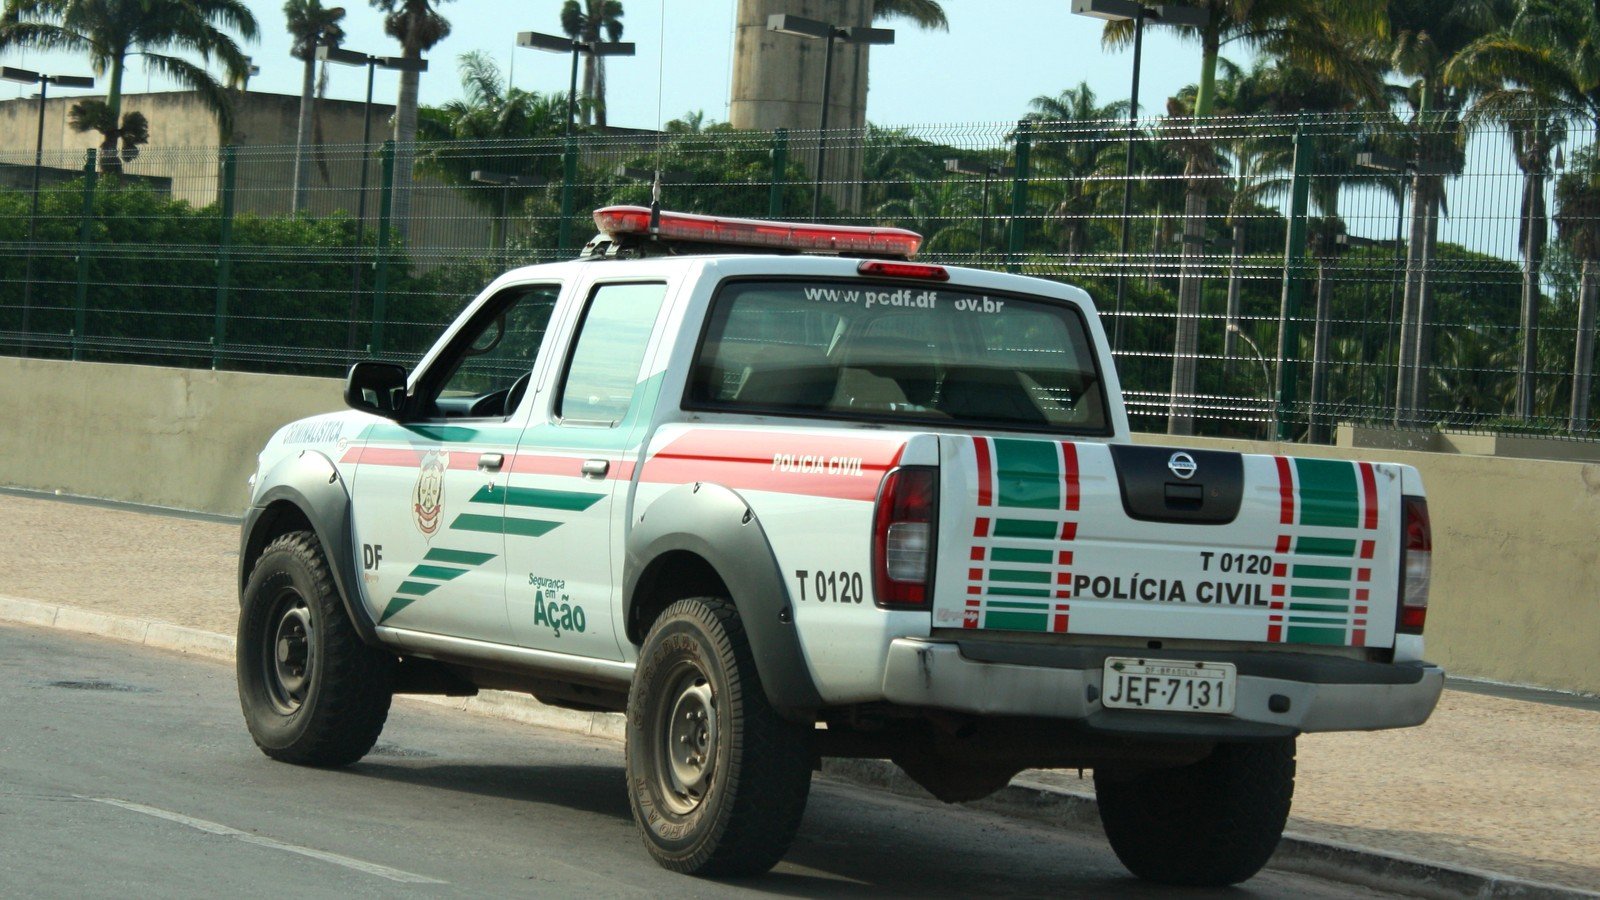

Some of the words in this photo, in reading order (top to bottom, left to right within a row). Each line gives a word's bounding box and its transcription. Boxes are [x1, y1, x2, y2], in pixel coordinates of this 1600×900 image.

[865, 289, 937, 308] pcdf.df
[828, 456, 864, 477] CIVIL
[363, 544, 383, 571] DF
[1200, 551, 1214, 571] T
[1220, 552, 1272, 575] 0120
[528, 572, 565, 592] Segurança
[545, 589, 556, 599] em
[795, 570, 808, 601] T
[815, 570, 863, 604] 0120
[1073, 572, 1186, 602] POLÍCIA
[1196, 581, 1269, 606] CIVIL
[534, 590, 586, 639] Ação
